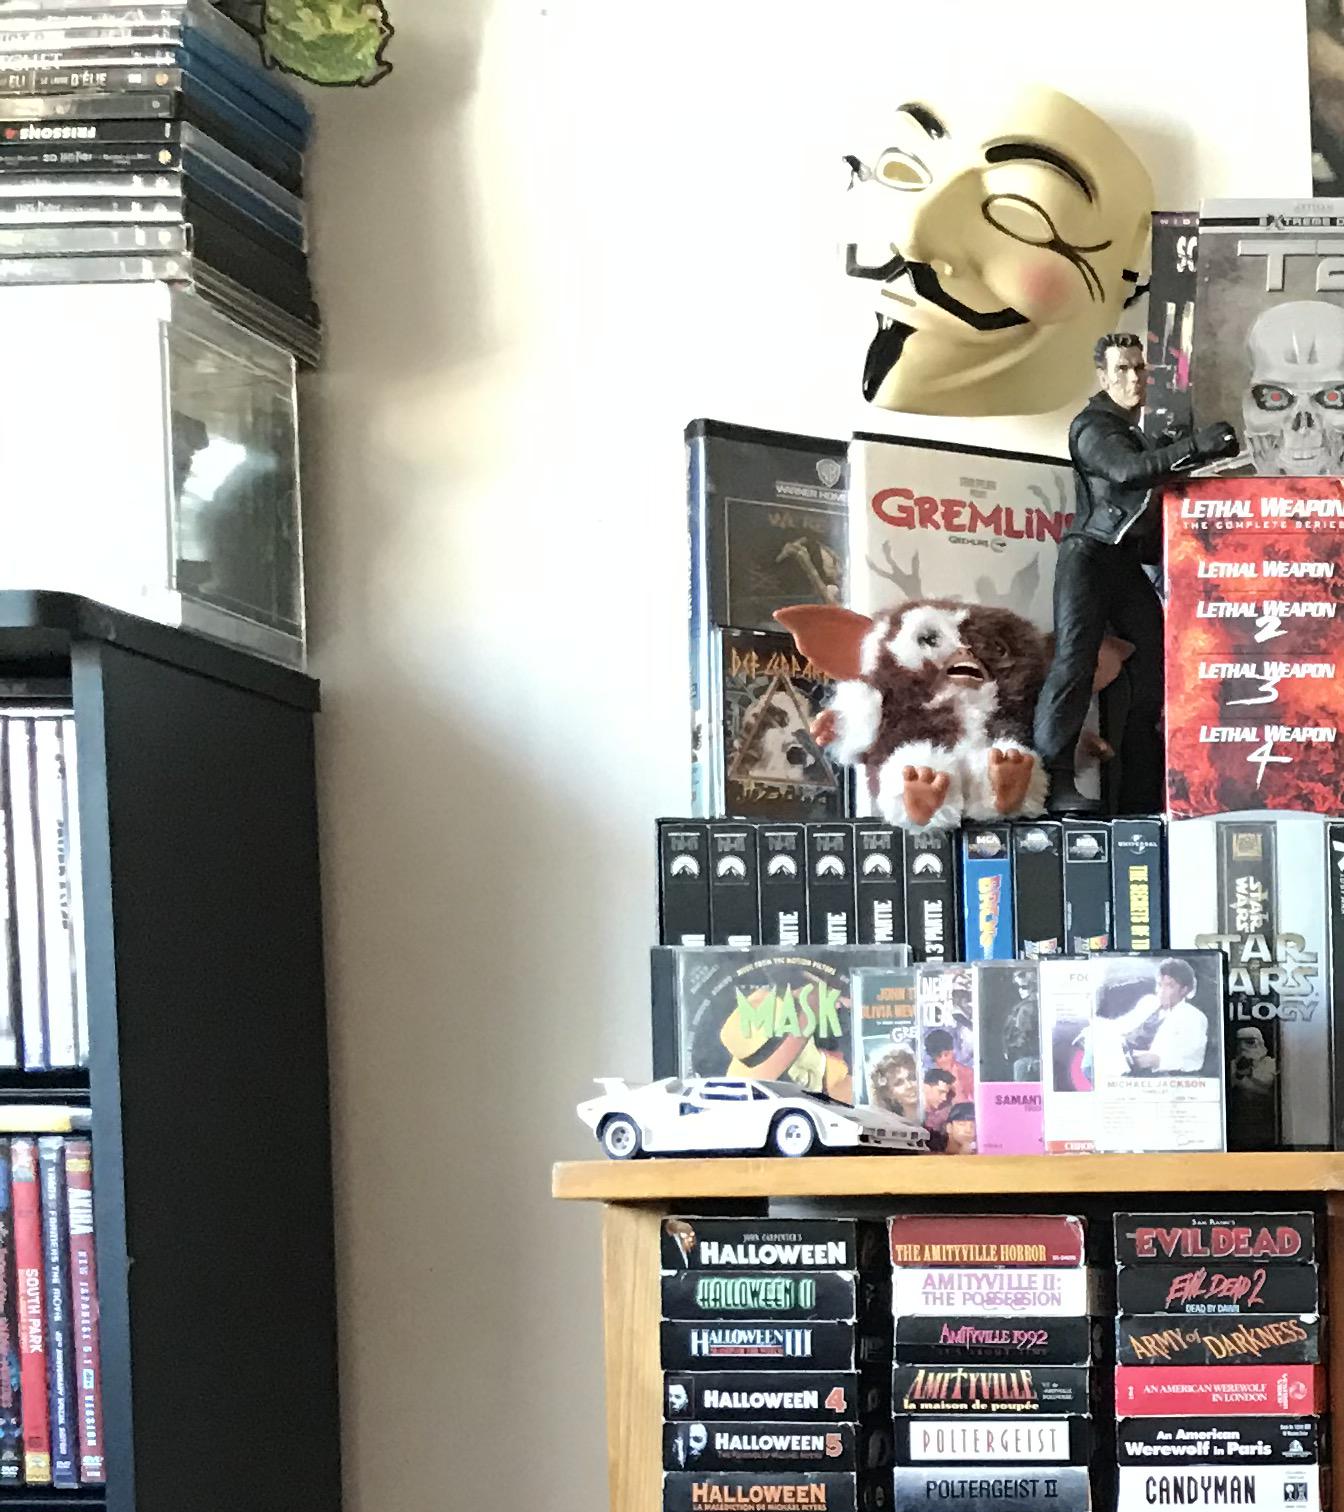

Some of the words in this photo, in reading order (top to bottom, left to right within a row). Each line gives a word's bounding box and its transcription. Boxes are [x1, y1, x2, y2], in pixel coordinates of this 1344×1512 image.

[1181, 498, 1255, 520] LETHAL
[1211, 521, 1284, 529] COMPLETE
[737, 983, 843, 1039] MASK
[1106, 1080, 1152, 1088] MICHAEL
[1156, 1079, 1207, 1088] JACKSON
[700, 1241, 846, 1265] HALLOWEEN
[26, 1268, 39, 1311] SOUTH
[30, 1314, 42, 1352] PARK
[704, 1391, 818, 1410] HALLOWEEN
[824, 1391, 846, 1411] 4
[1157, 1430, 1172, 1441] An
[1176, 1429, 1240, 1441] American
[1125, 1441, 1209, 1457] Werewolf
[1227, 1441, 1272, 1457] Paris
[1146, 1476, 1256, 1505] CANDYMAN
